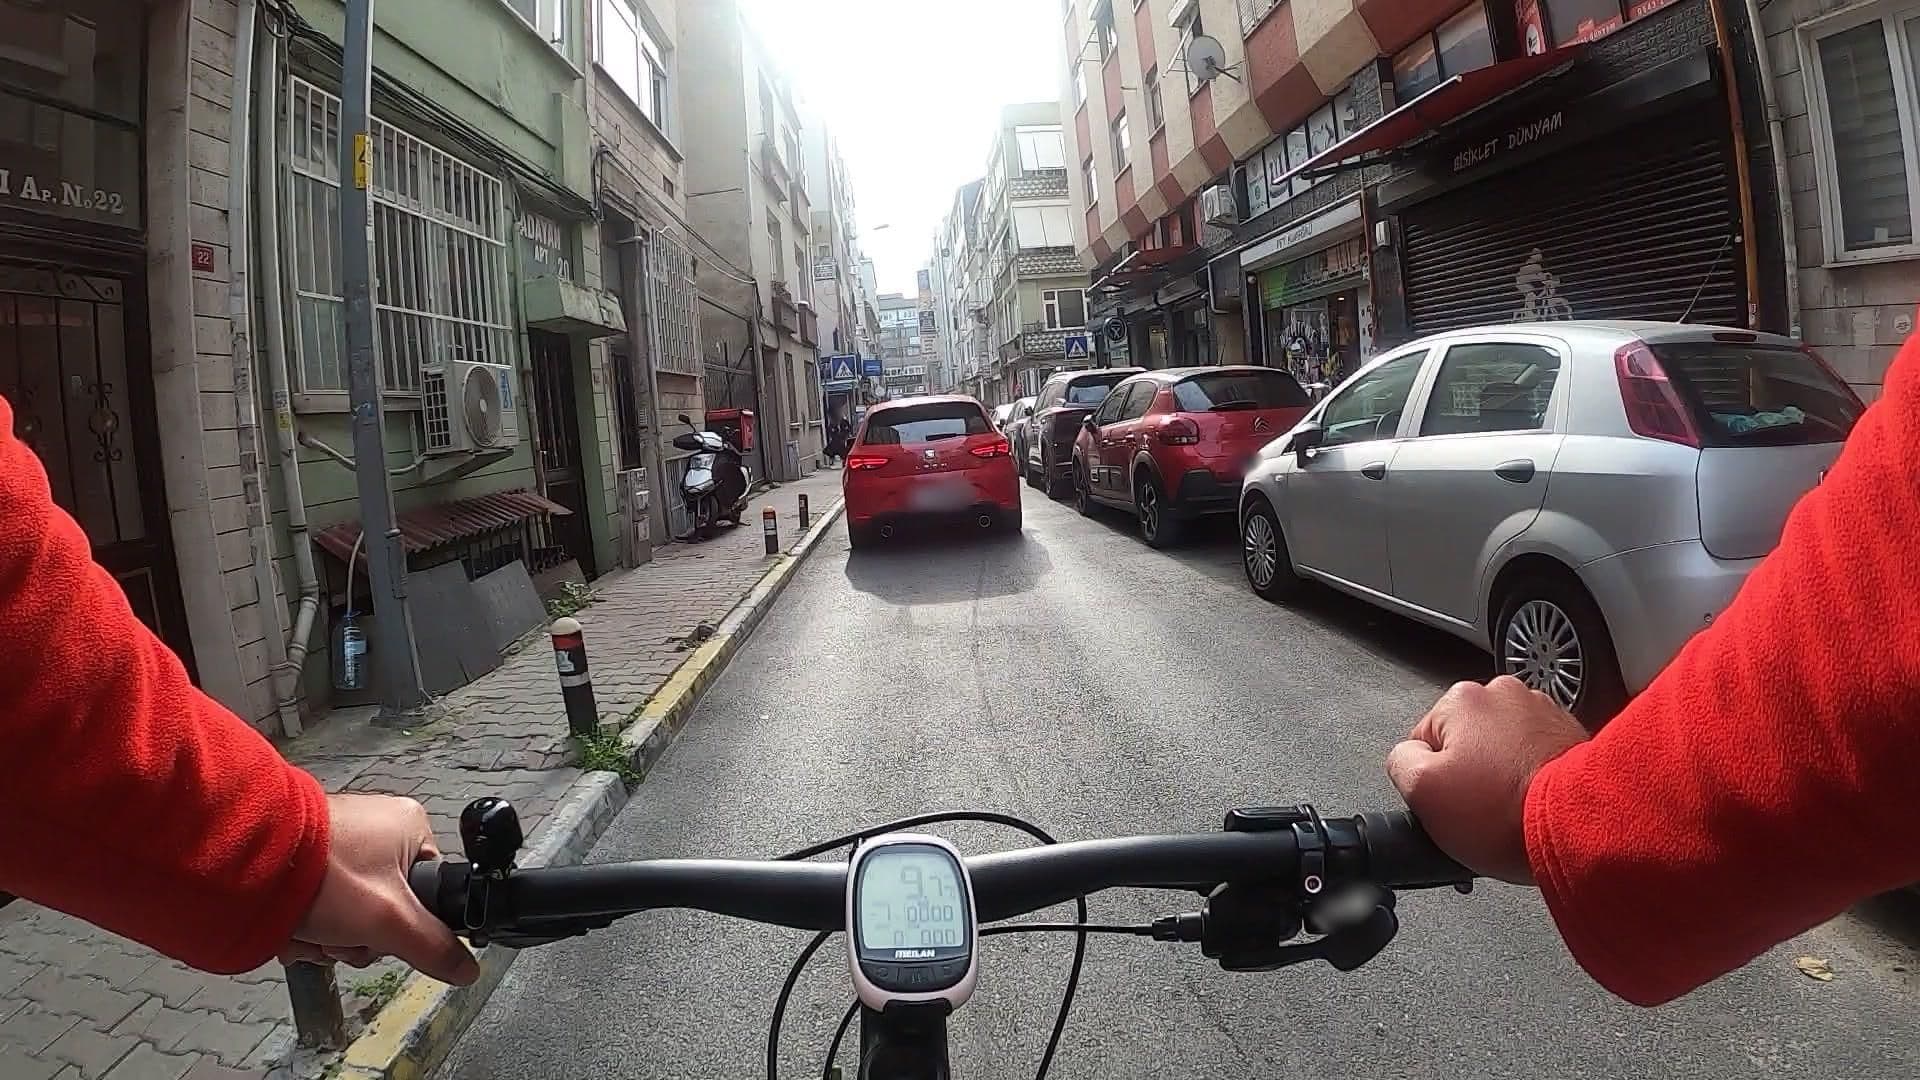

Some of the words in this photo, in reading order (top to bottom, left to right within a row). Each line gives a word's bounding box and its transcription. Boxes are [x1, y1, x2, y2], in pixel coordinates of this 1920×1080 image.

[1508, 112, 1562, 149] DÜNYAM
[198, 251, 209, 265] 22
[558, 257, 570, 281] 20
[895, 949, 935, 959] MEILAN
